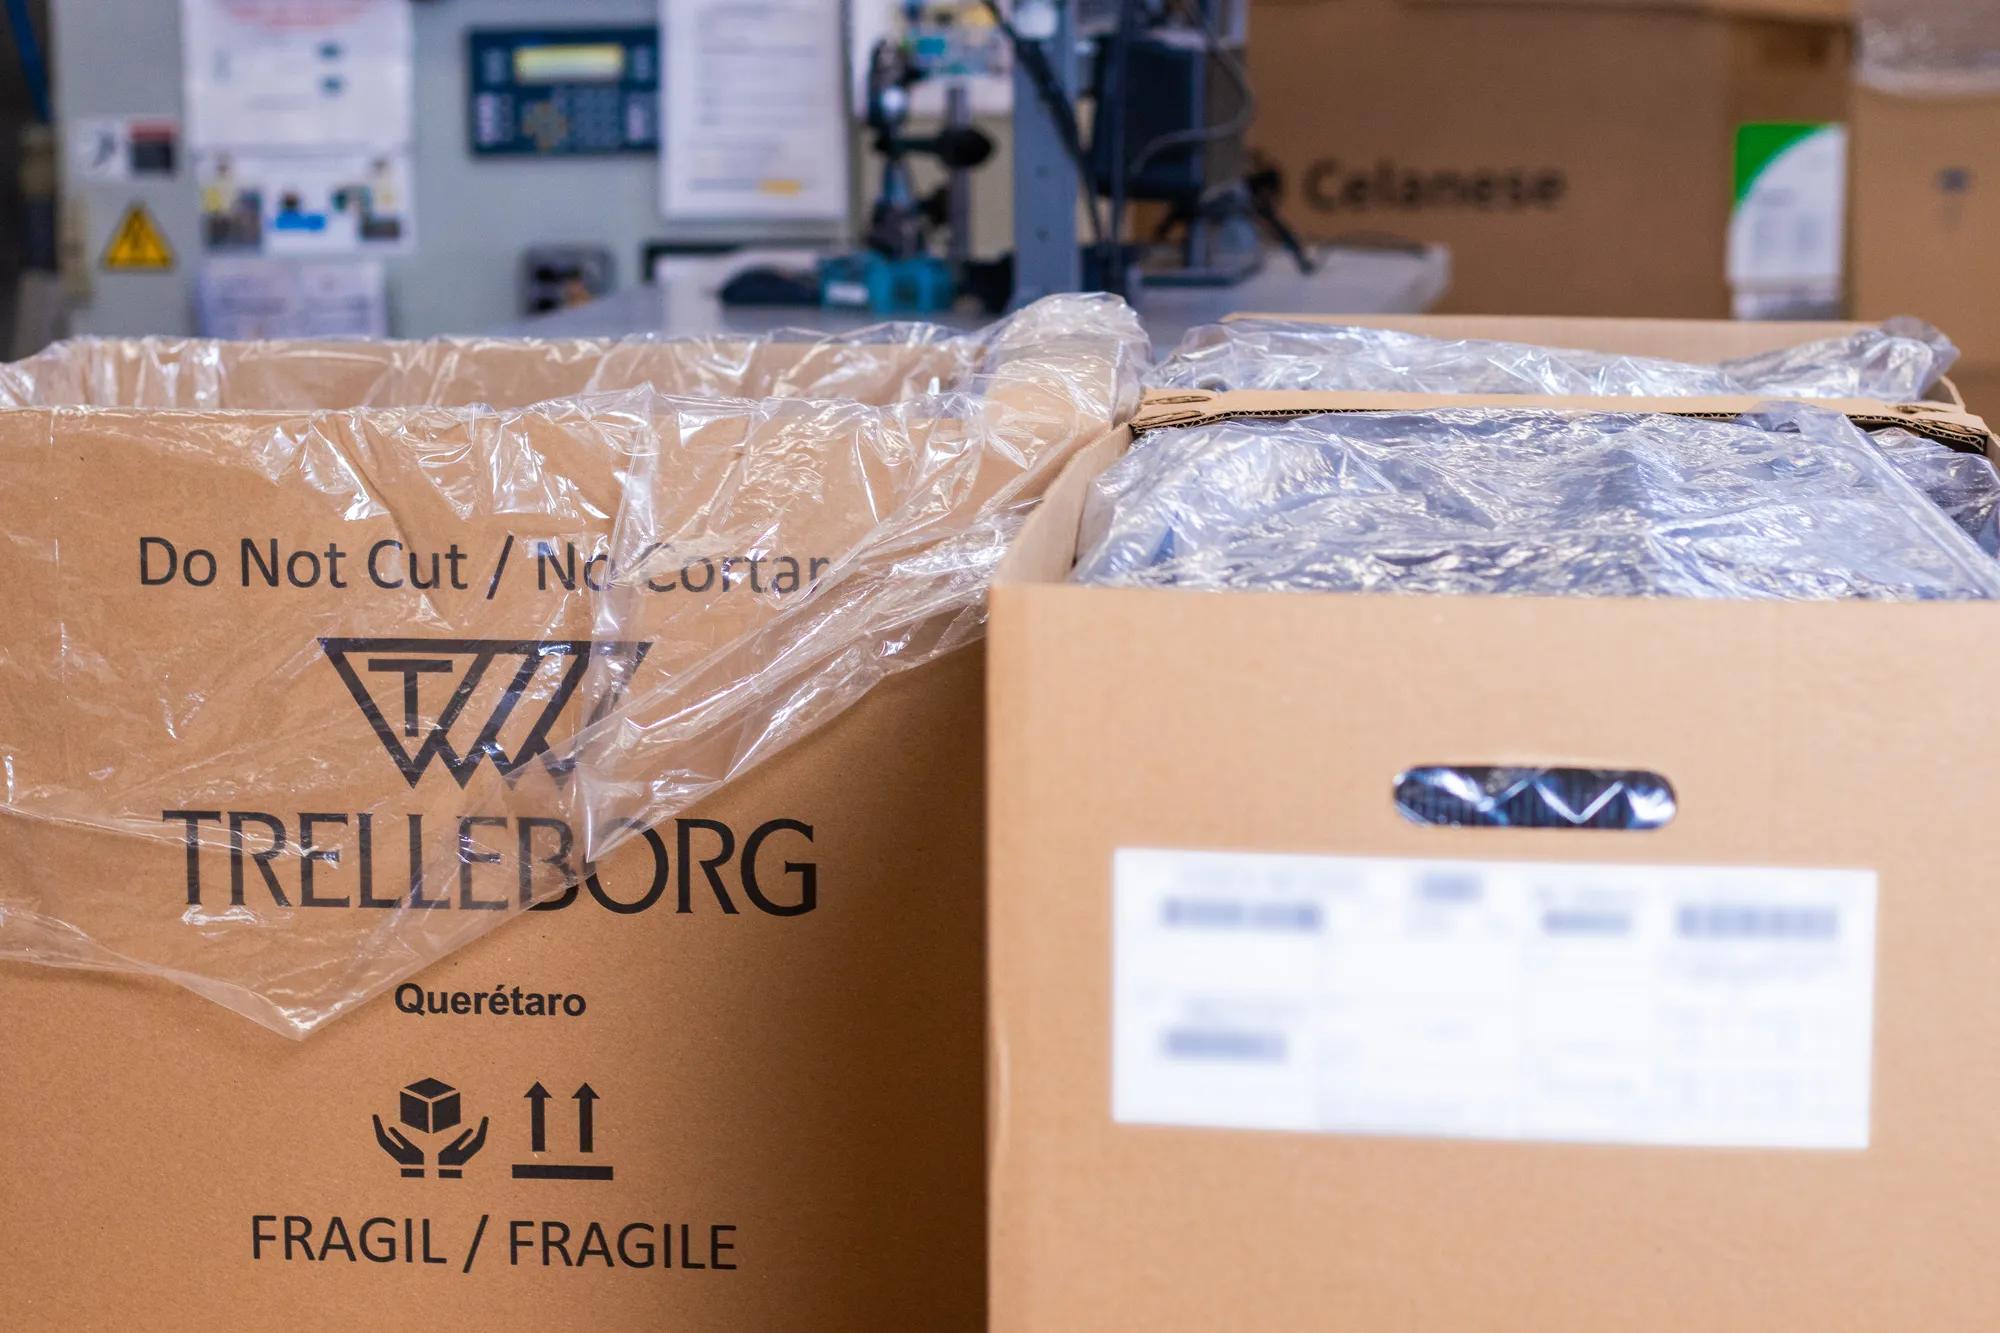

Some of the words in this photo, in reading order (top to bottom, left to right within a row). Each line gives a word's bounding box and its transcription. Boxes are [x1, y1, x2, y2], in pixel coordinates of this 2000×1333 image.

[1304, 157, 1567, 213] Celanese
[139, 536, 218, 587] Do
[240, 537, 347, 589] Not
[367, 539, 468, 590] Cut
[485, 534, 514, 600] /
[537, 541, 616, 592] No
[643, 541, 830, 594] Cortar
[161, 809, 818, 918] TRELLEBORG
[394, 982, 587, 1017] Querétaro
[251, 1214, 447, 1264] FRAGIL
[462, 1214, 489, 1273] /
[509, 1220, 738, 1271] FRAGILE
